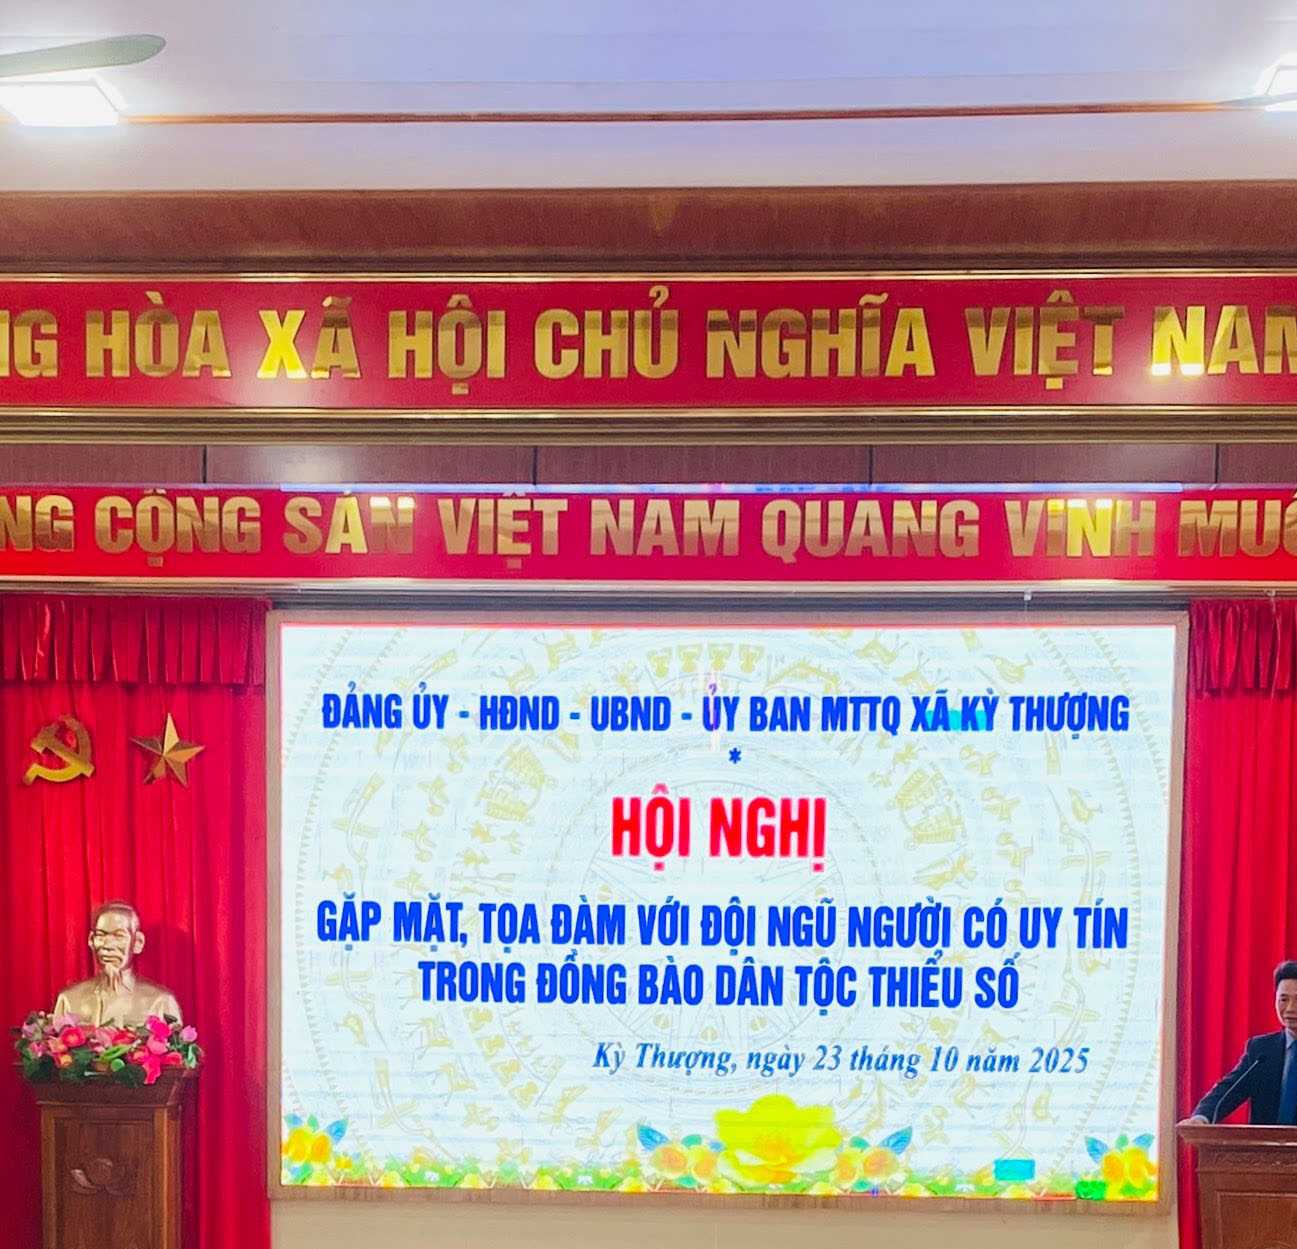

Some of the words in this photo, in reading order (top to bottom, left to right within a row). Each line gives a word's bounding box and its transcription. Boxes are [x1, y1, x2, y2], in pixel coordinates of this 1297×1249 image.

[85, 290, 232, 378] HÒA
[257, 296, 361, 379] XÃ
[388, 294, 506, 395] HỘI
[534, 285, 679, 378] CHỦ
[706, 292, 936, 378] NGHĨA
[964, 290, 1125, 390] VIỆT
[94, 488, 261, 567] CỘNG
[437, 492, 568, 569] VIỆT
[590, 499, 740, 557] NAM
[761, 499, 980, 563] QUANG
[322, 681, 402, 729] ĐẢNG
[412, 681, 448, 729] ỦY
[479, 695, 560, 731] HĐND
[590, 696, 671, 732] UBND
[703, 682, 739, 732] ỦY
[749, 696, 810, 732] BAN
[821, 696, 901, 736] MTTQ
[912, 689, 951, 732] XÃ
[961, 687, 1000, 732] KỲ
[1009, 692, 1129, 740] THƯỢNG
[611, 783, 691, 871] HỘI
[709, 797, 826, 872] NGHỊ
[316, 891, 381, 951] GẶP
[393, 892, 468, 952] MẶT,
[479, 903, 540, 953] TỌA
[551, 895, 625, 945] ĐÀM
[637, 895, 690, 946] VỚI
[700, 896, 755, 956] ĐỘI
[767, 898, 836, 948] NGŨ
[847, 896, 951, 949] NGƯỜI
[963, 898, 1006, 949] CÓ
[1019, 907, 1062, 949] UY
[1073, 898, 1129, 949] TÍN
[418, 961, 525, 1003] TRONG
[638, 956, 703, 1006] BÀO
[715, 957, 783, 1007] DÂN
[795, 957, 857, 1016] TỘC
[868, 950, 963, 1008] THIỂU
[975, 952, 1020, 1008] SỐ
[635, 1042, 736, 1076] Thượng,
[746, 1046, 806, 1077] ngày
[813, 1045, 842, 1072] 23
[849, 1045, 921, 1078] tháng
[932, 1045, 959, 1073] 10
[966, 1048, 1020, 1074] năm
[1028, 1047, 1089, 1074] 2025
